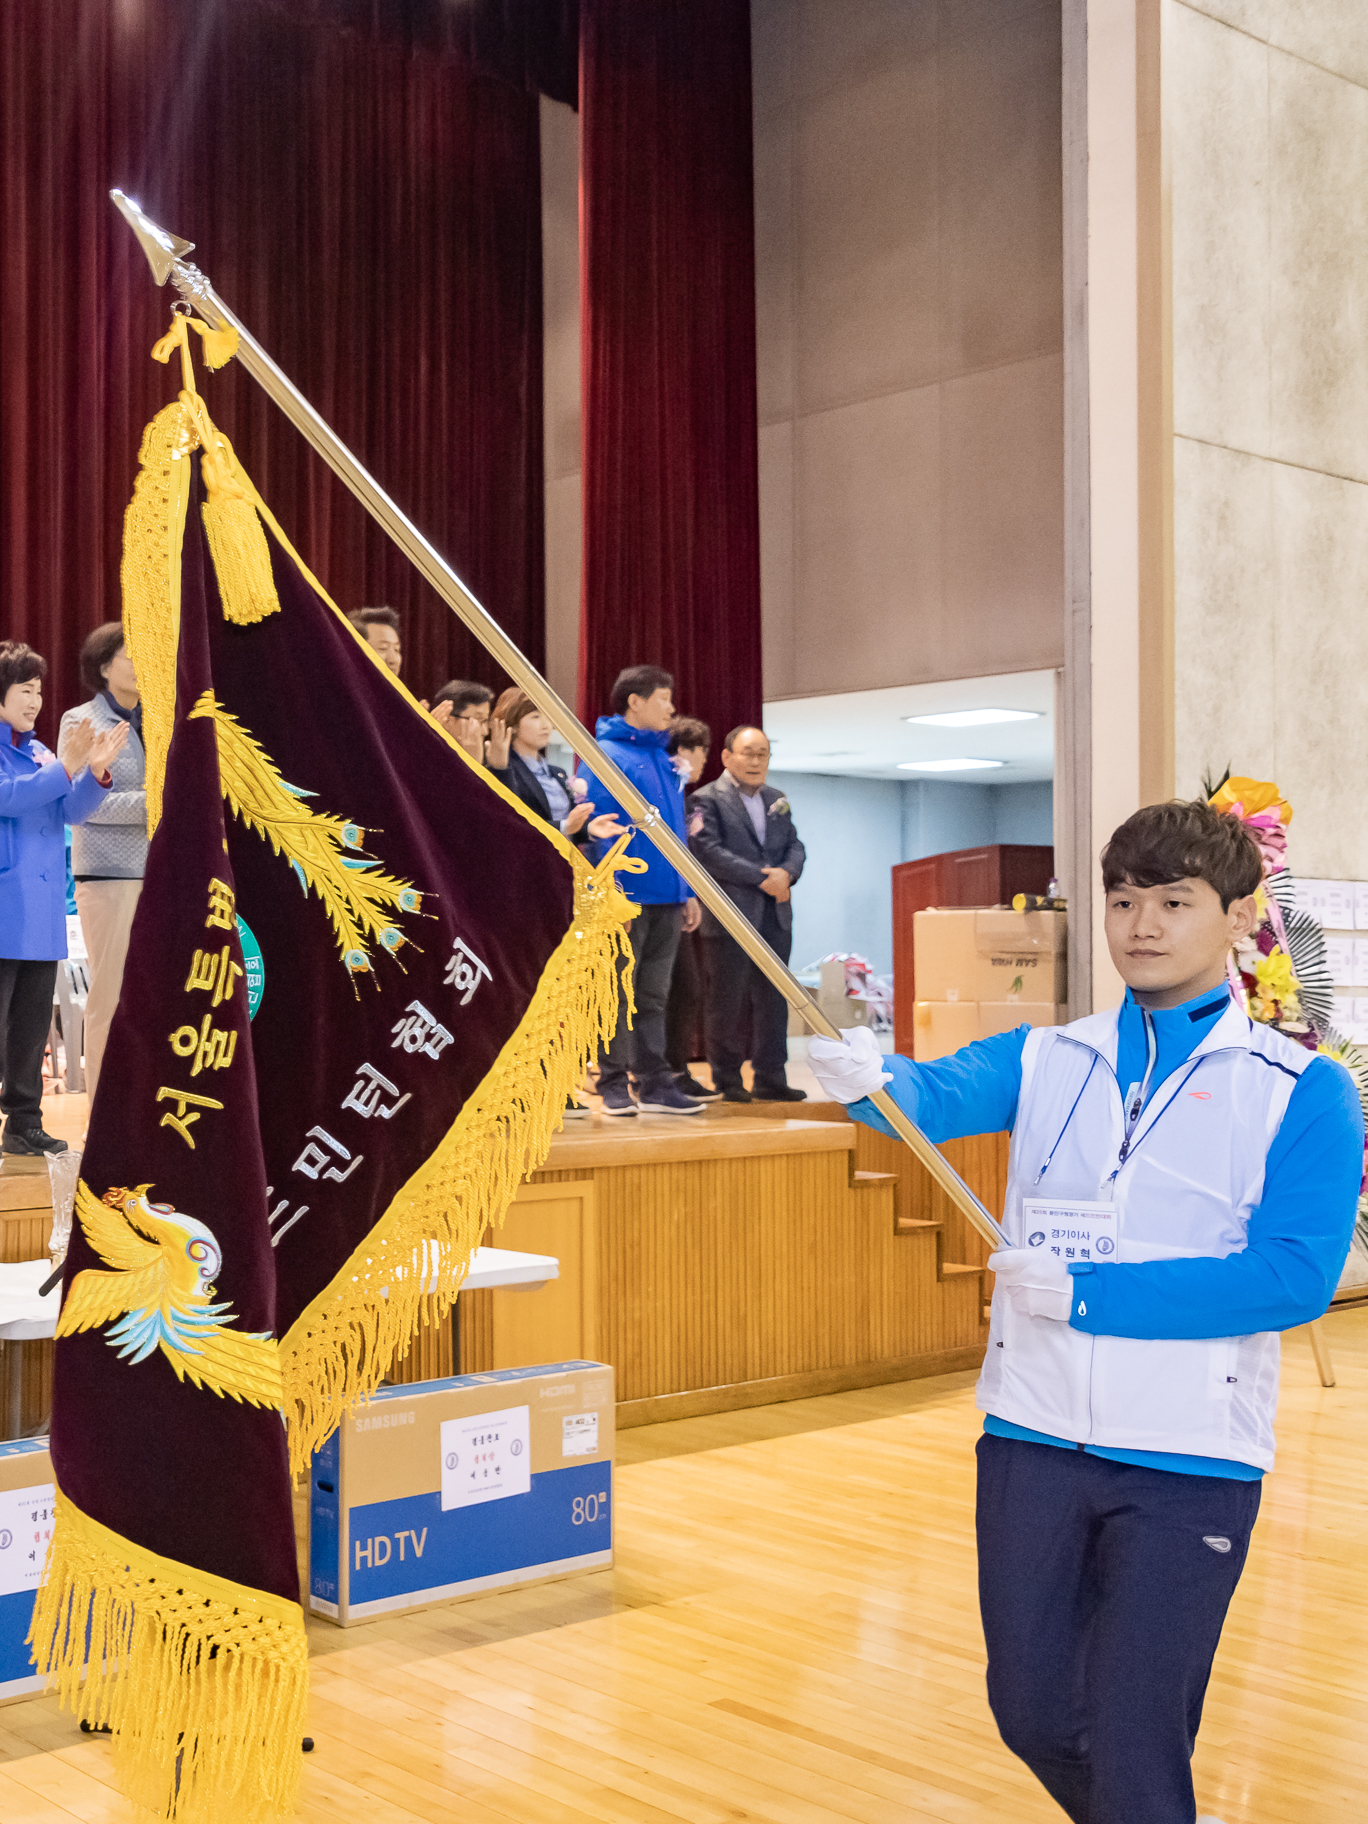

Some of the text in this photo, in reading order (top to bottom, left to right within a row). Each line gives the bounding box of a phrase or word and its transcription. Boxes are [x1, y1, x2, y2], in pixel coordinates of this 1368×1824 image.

[156, 842, 243, 1149] 서울특별
[1051, 1228, 1091, 1241] 경기이사
[355, 1411, 416, 1433] SAMSUNG
[572, 1494, 599, 1525] 80
[355, 1527, 428, 1571] HD TV
